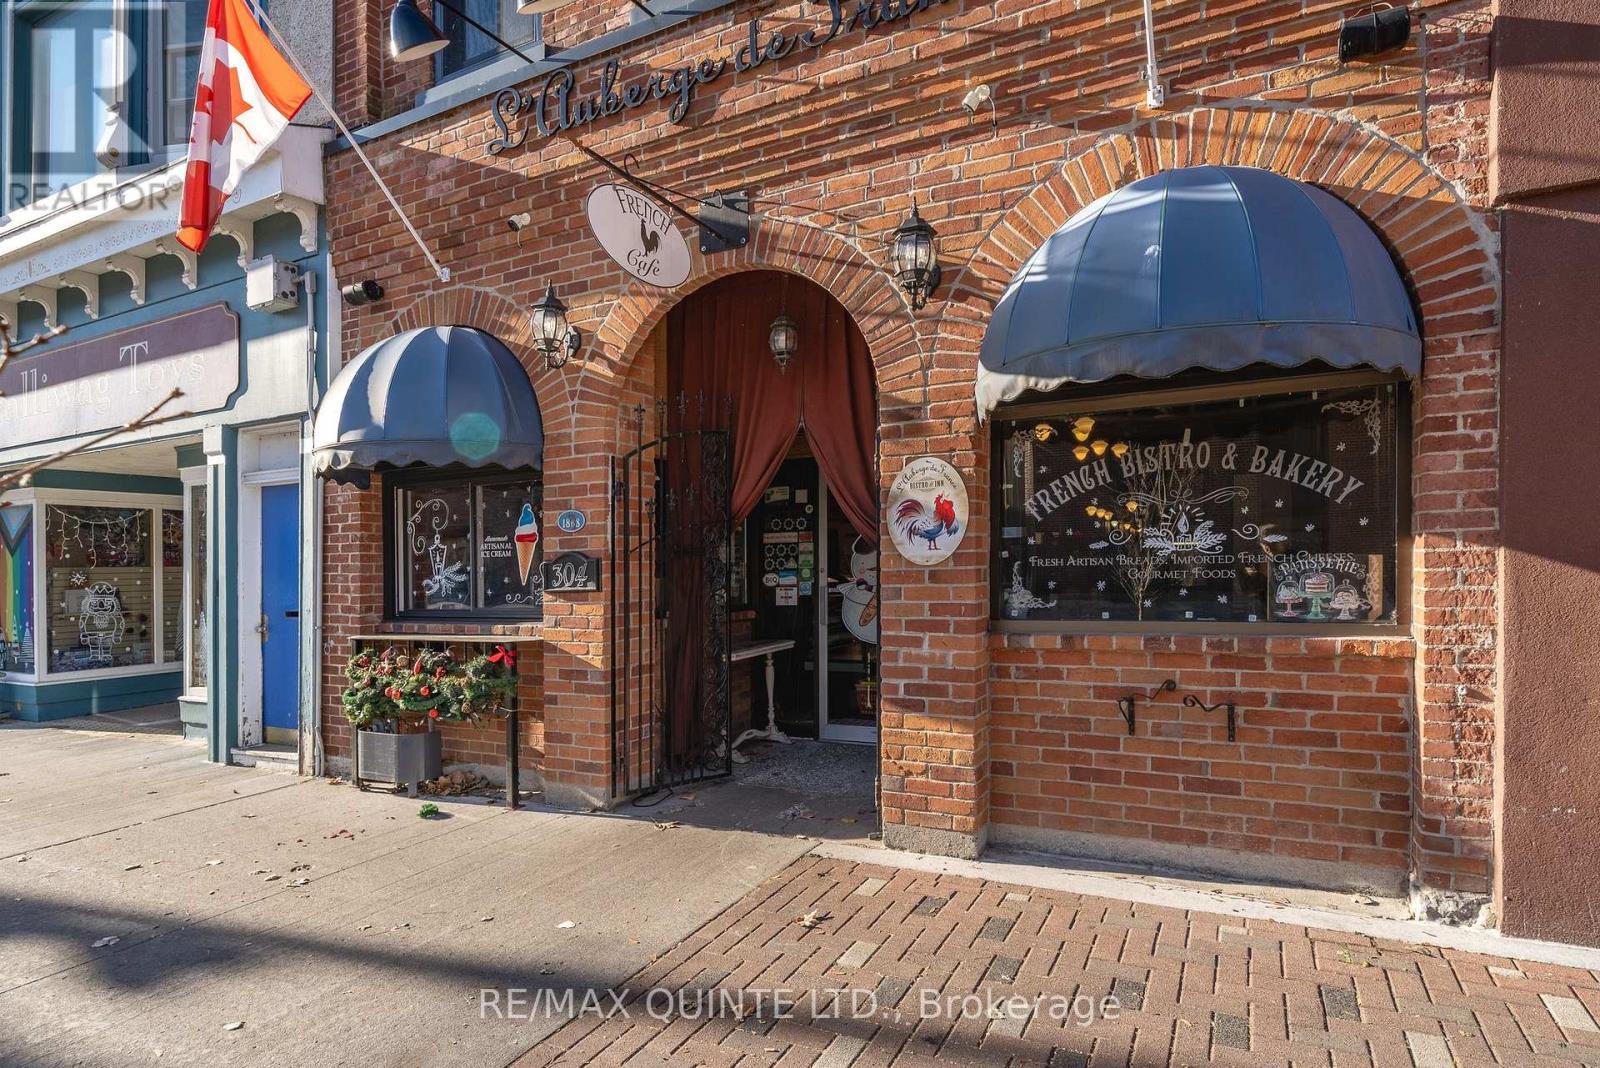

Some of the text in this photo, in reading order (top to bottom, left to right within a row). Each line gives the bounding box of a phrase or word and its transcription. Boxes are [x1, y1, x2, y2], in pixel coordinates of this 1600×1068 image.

[485, 57, 726, 155] L'Auberge
[734, 17, 798, 73] de
[615, 188, 672, 236] FRENCH
[118, 340, 206, 394] Toys
[909, 480, 929, 489] BISTRO
[1023, 440, 1366, 523] FRENCH BISTRO & BAKERY
[480, 541, 513, 550] ARTISANAL
[480, 550, 512, 558] ICE CREAM
[1028, 555, 1065, 567] FRESH
[1066, 554, 1114, 567] ARTISAN
[1171, 553, 1235, 565] IMPORTED
[1237, 551, 1294, 564] FRENCH
[551, 561, 589, 588] 304
[1127, 567, 1236, 580] GOURMET FOODS
